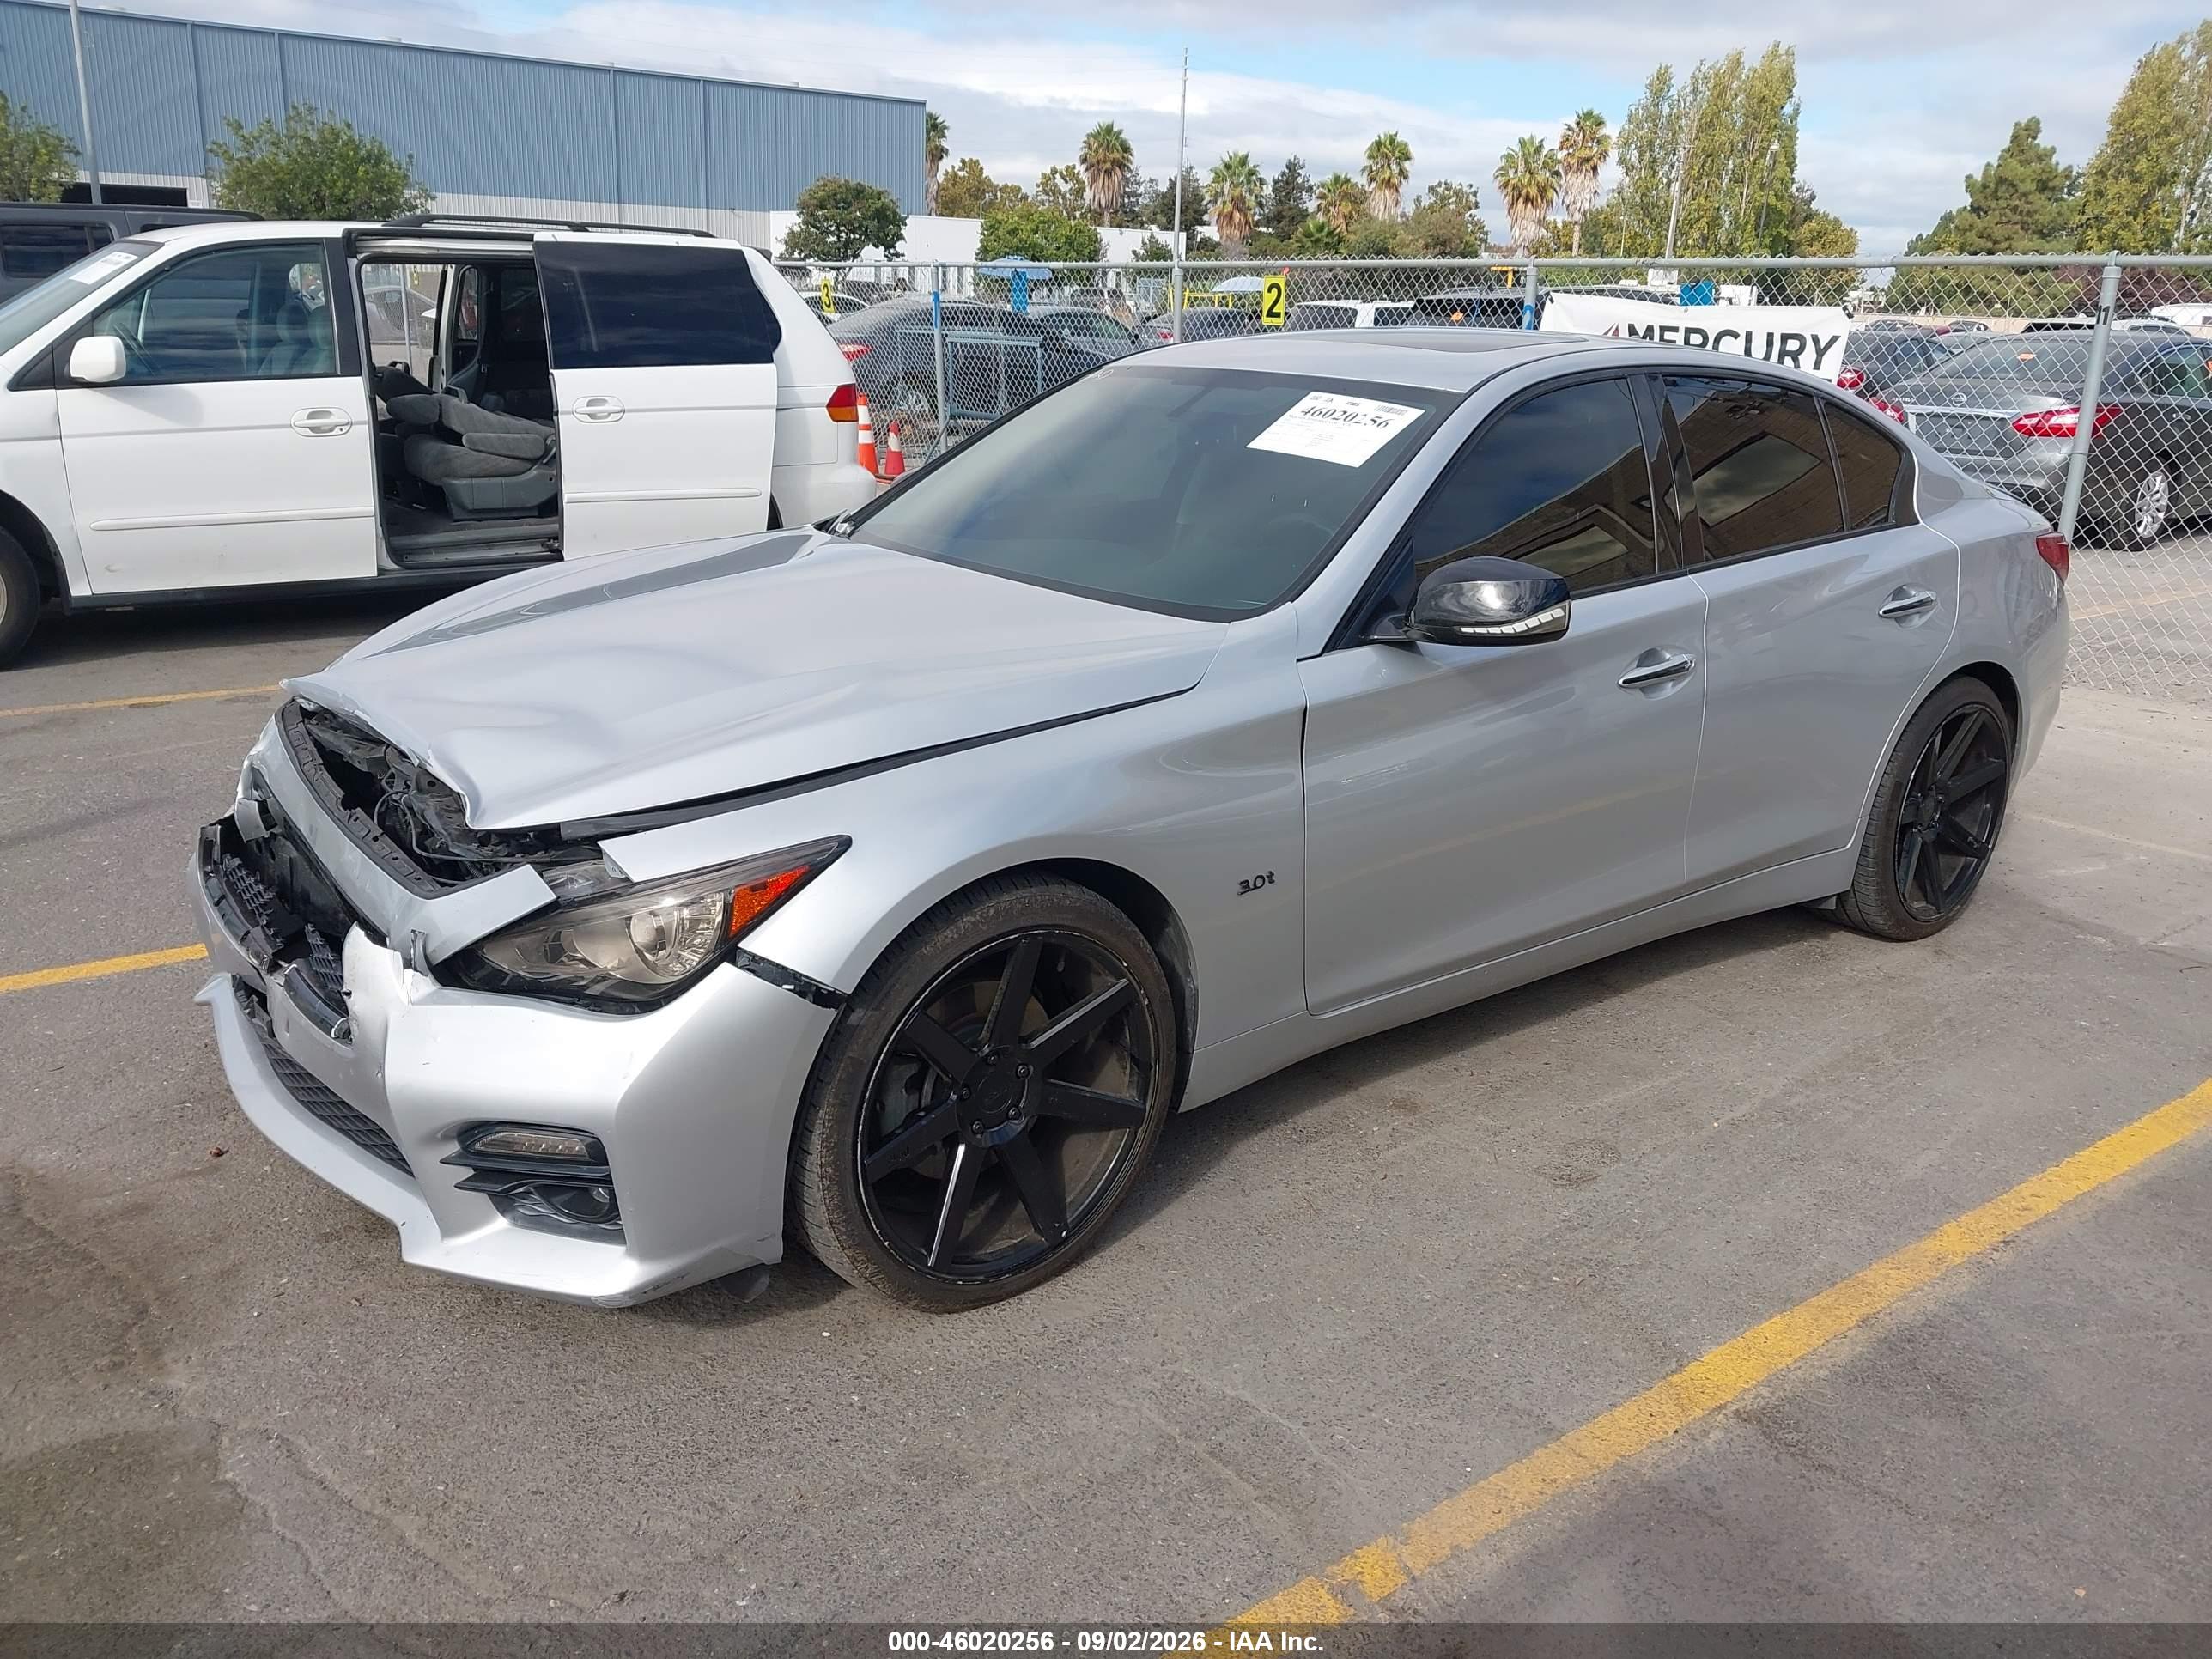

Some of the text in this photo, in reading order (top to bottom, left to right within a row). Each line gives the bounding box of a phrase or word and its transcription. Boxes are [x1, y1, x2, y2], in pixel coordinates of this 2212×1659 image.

[823, 283, 831, 308] 3
[1266, 283, 1282, 318] 2
[1300, 405, 1395, 428] 46020256
